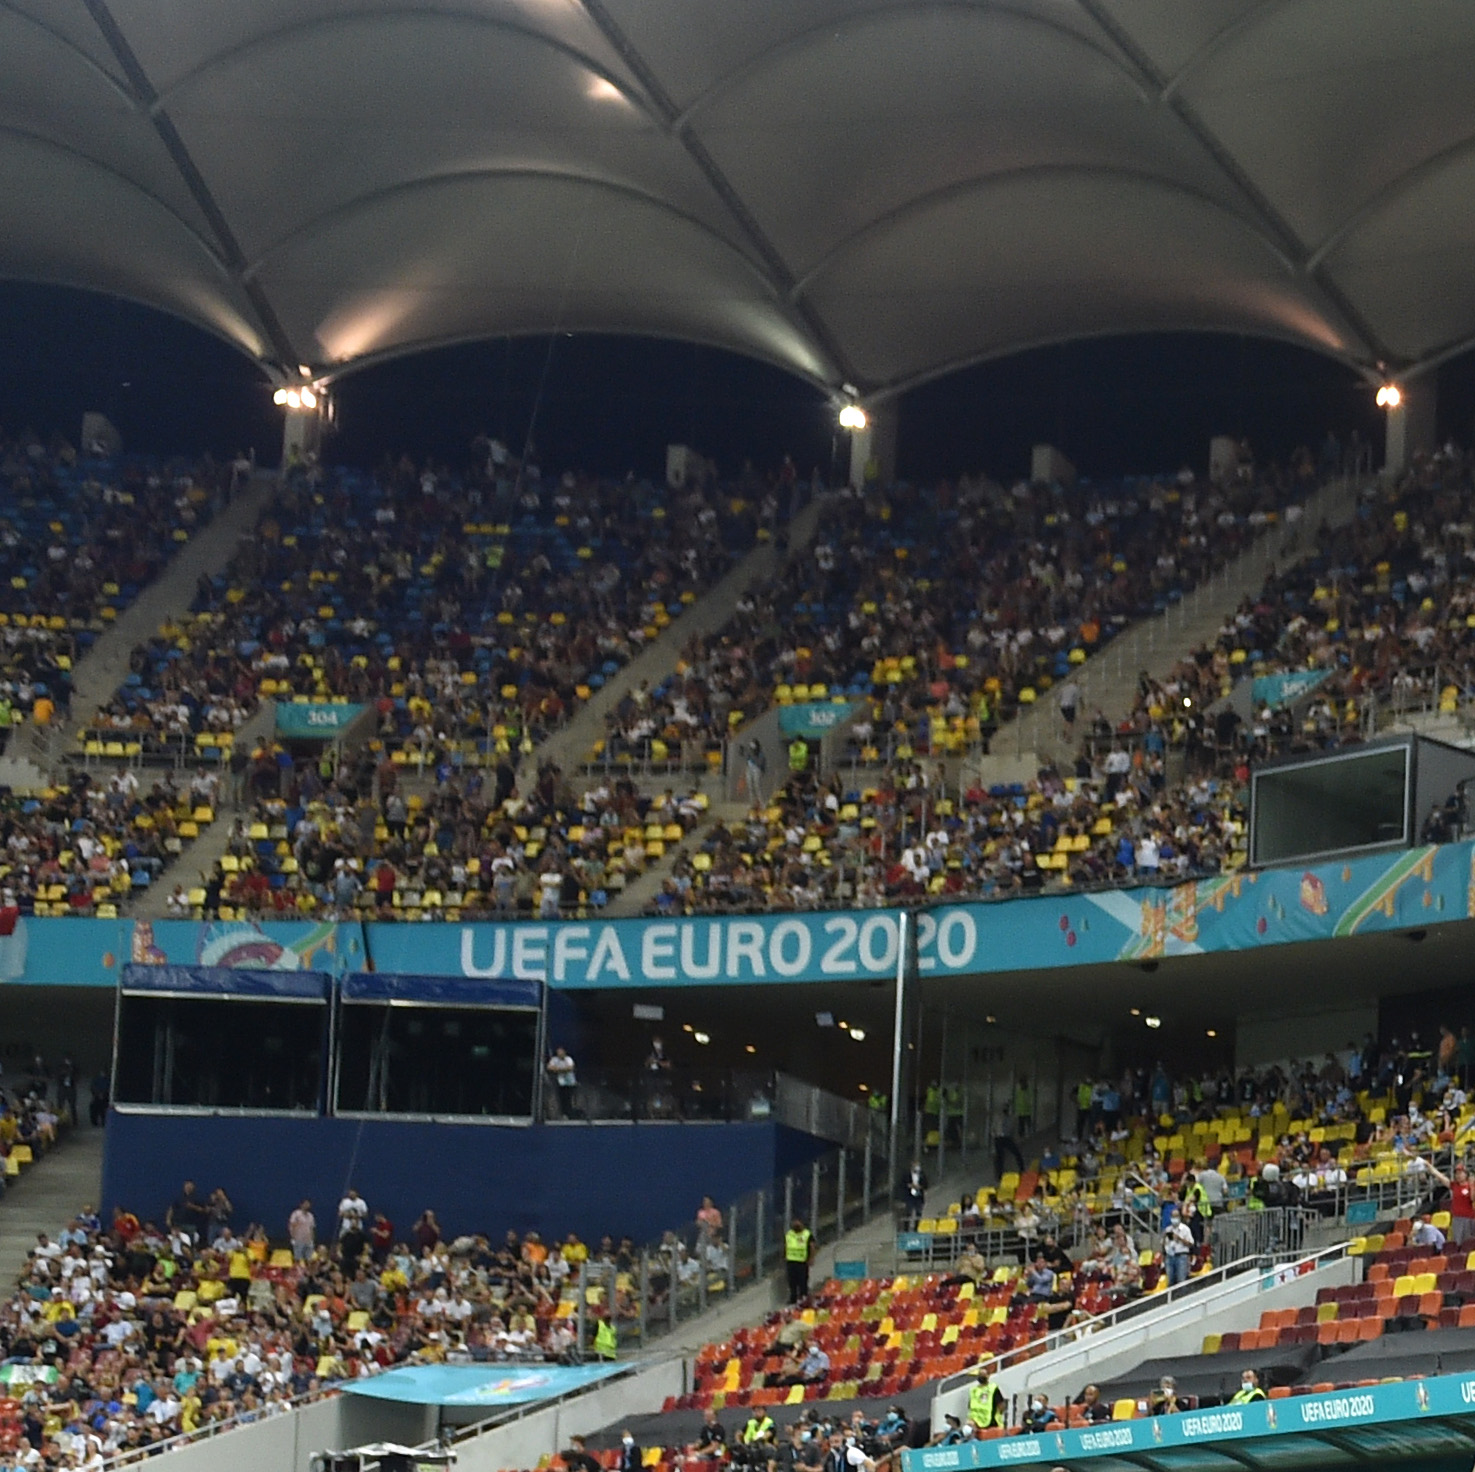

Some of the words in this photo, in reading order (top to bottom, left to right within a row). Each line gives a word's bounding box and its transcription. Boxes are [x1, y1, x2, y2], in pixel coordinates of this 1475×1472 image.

[460, 925, 632, 981] UEFA
[641, 919, 813, 979] EURO
[820, 910, 977, 974] 2020
[1301, 1403, 1325, 1423] UEFA
[1324, 1400, 1350, 1420] EURO
[1350, 1395, 1375, 1416] 2020
